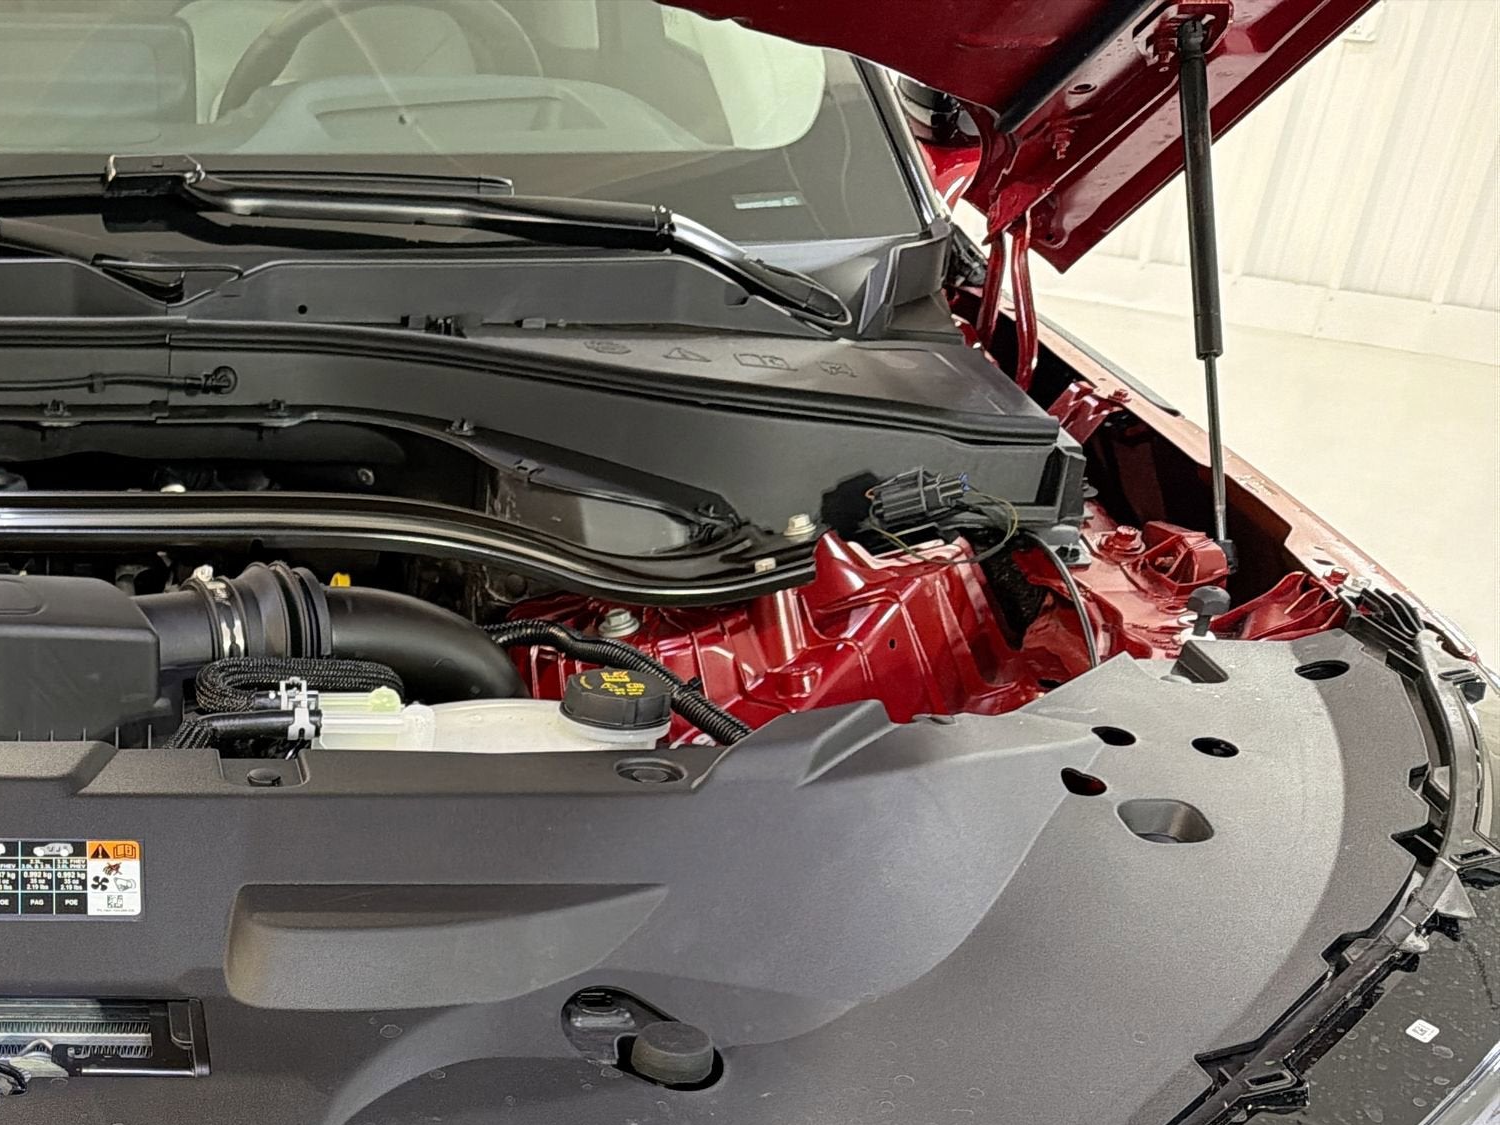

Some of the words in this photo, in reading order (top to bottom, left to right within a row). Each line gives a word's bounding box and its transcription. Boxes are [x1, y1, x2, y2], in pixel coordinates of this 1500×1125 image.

[6, 871, 16, 880] kg
[43, 871, 52, 880] kg
[76, 871, 86, 880] kg
[30, 898, 45, 906] PAG
[64, 898, 79, 906] POE
